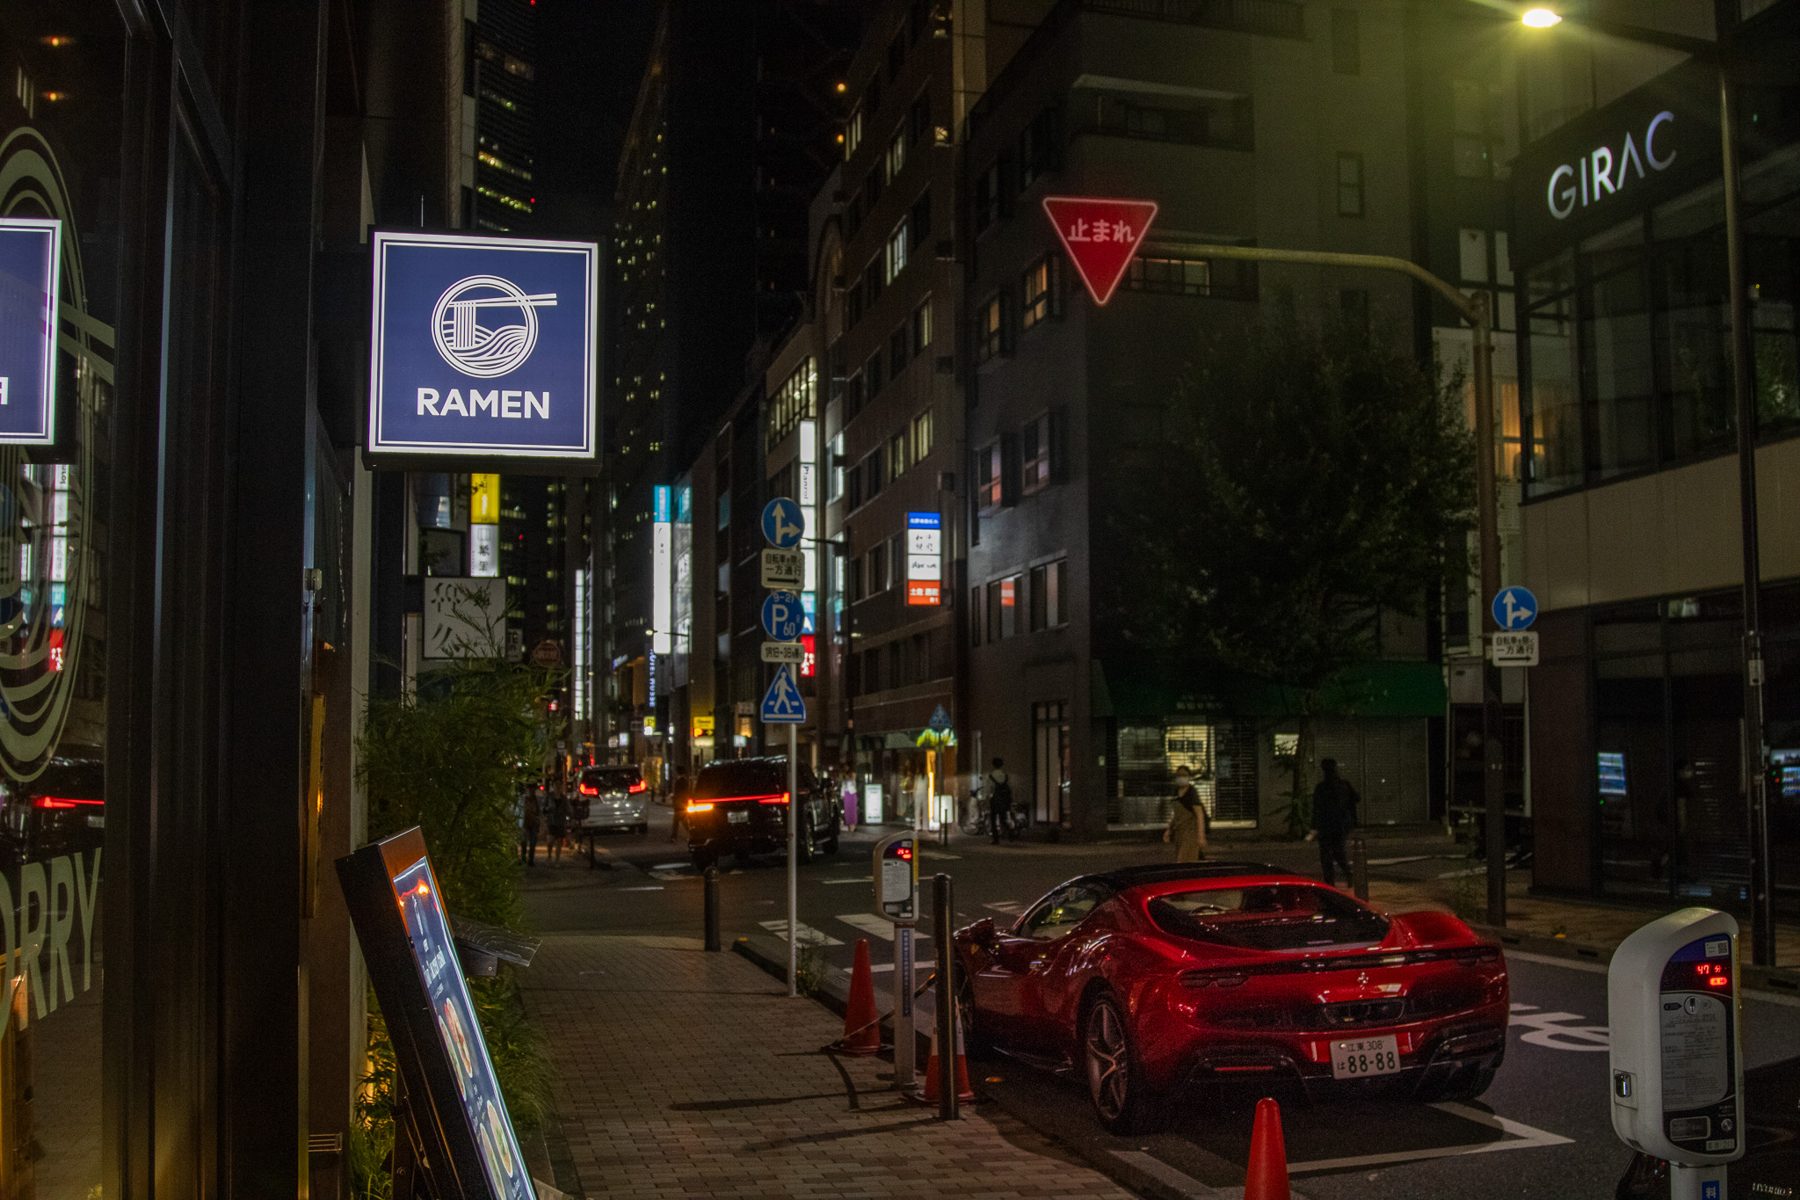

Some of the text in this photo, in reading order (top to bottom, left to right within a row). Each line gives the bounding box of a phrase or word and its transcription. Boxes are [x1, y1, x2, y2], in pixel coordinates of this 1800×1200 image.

[1547, 111, 1677, 219] GIRAC
[1067, 217, 1135, 243] 止まれ
[416, 387, 550, 419] RAMEN
[765, 565, 801, 577] 一方通行
[772, 604, 788, 635] P
[1496, 645, 1534, 655] 一方通行
[1367, 1040, 1384, 1051] 308
[1347, 1051, 1396, 1074] 88-88
